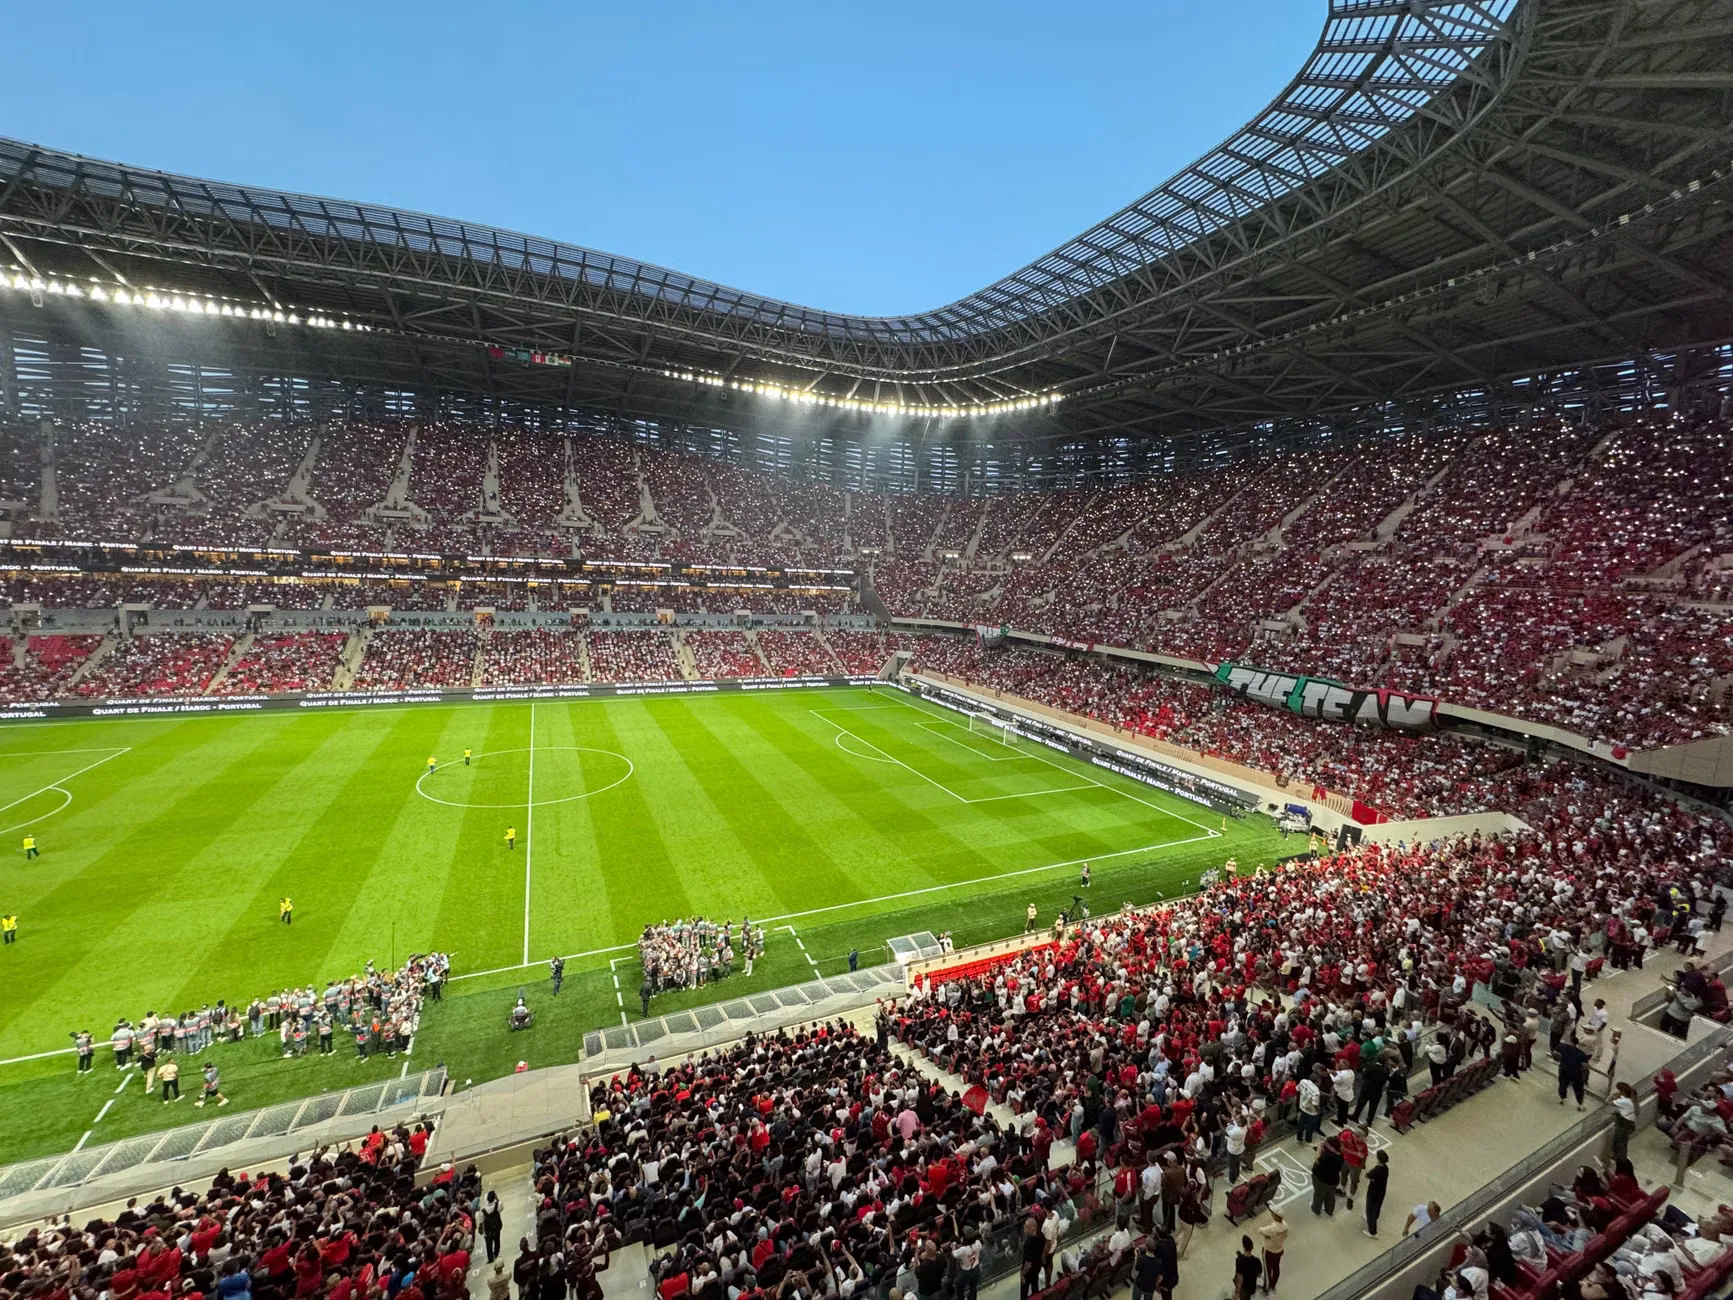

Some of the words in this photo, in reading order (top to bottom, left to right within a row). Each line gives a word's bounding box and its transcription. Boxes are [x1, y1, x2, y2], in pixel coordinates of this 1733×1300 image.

[1092, 757, 1111, 771] QUART
[1120, 767, 1142, 782] FINALE
[1146, 778, 1169, 792] MAROC
[1174, 788, 1212, 808] PORTUGAL
[1116, 750, 1136, 762] QUART
[1136, 756, 1145, 765] DE
[1144, 759, 1167, 773] FINALE
[1172, 768, 1195, 783] MAROC
[1201, 779, 1238, 798] PORTUGAL
